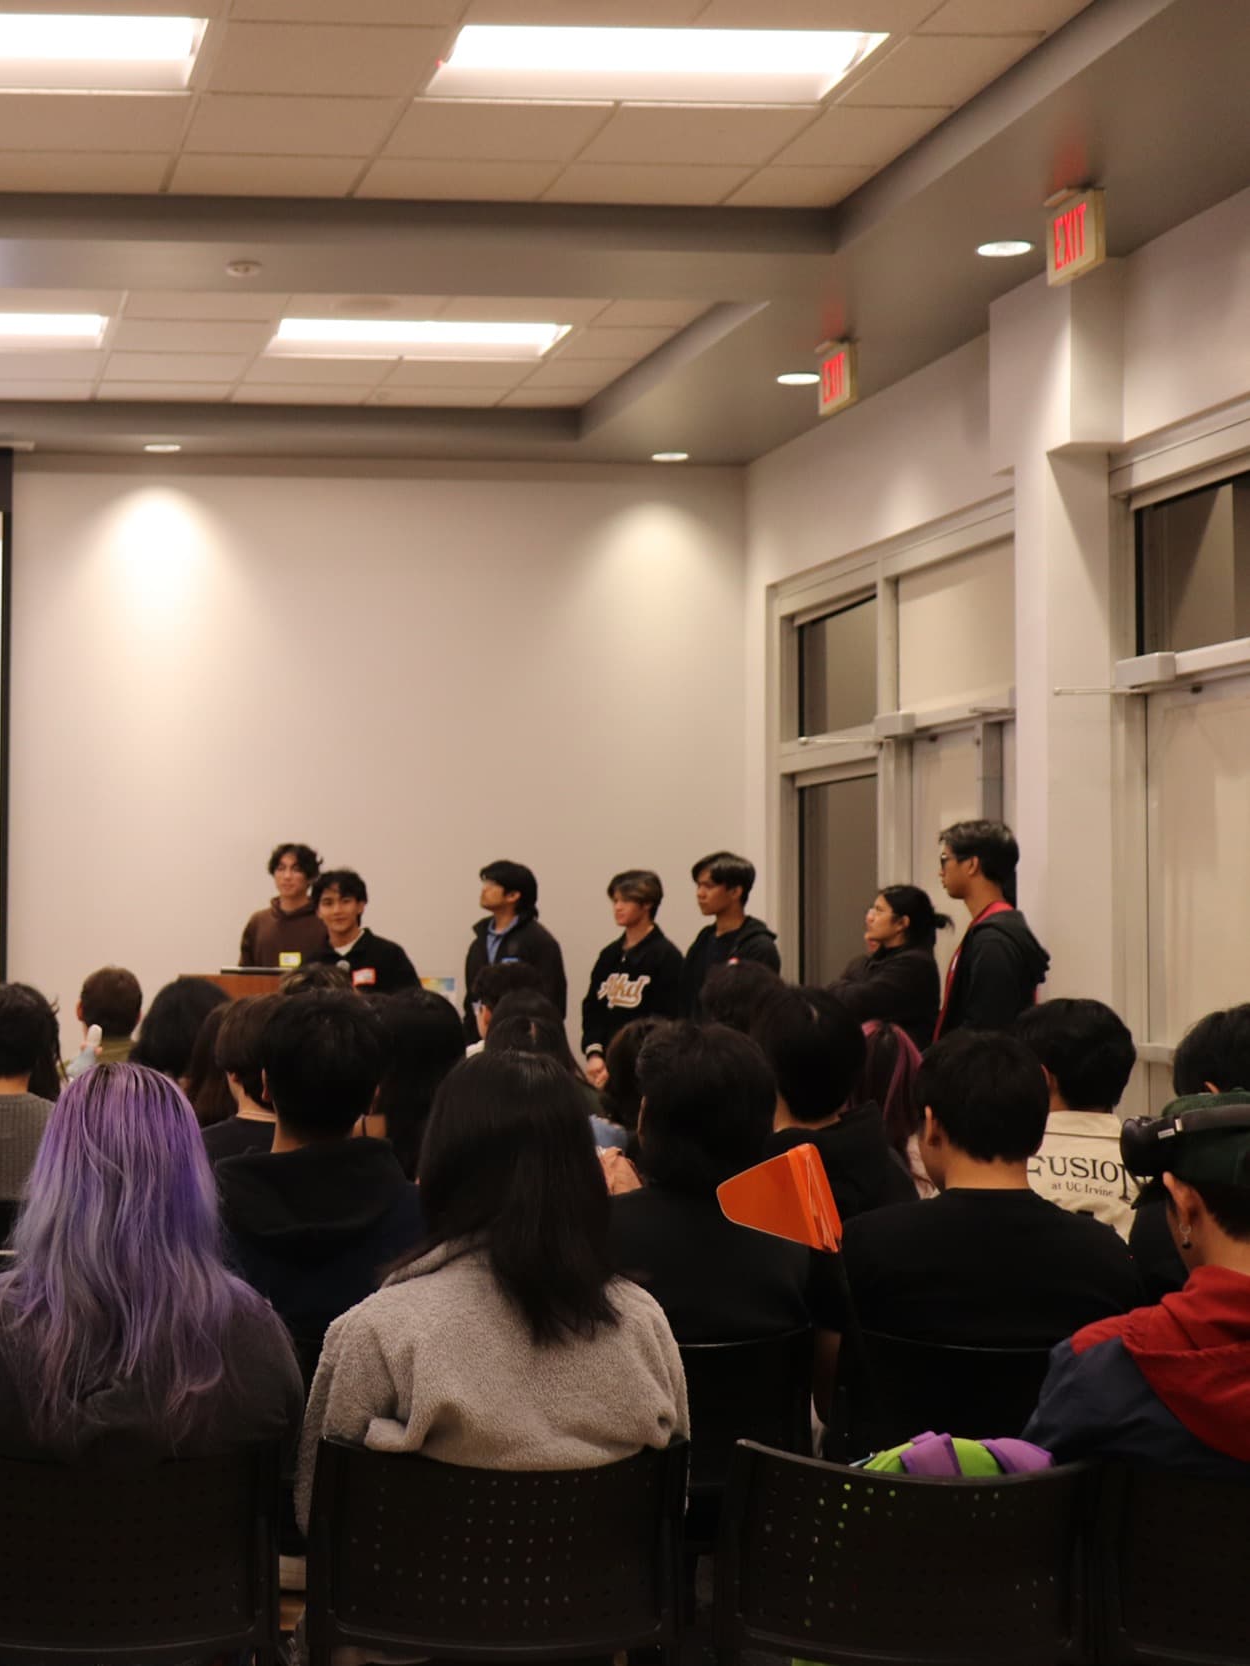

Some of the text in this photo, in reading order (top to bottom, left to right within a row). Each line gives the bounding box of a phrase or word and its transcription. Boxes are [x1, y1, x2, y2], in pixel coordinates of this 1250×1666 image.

[1054, 203, 1086, 271] EXIT
[822, 352, 845, 404] EXIT
[1052, 1182, 1114, 1197] at UC Irvine
